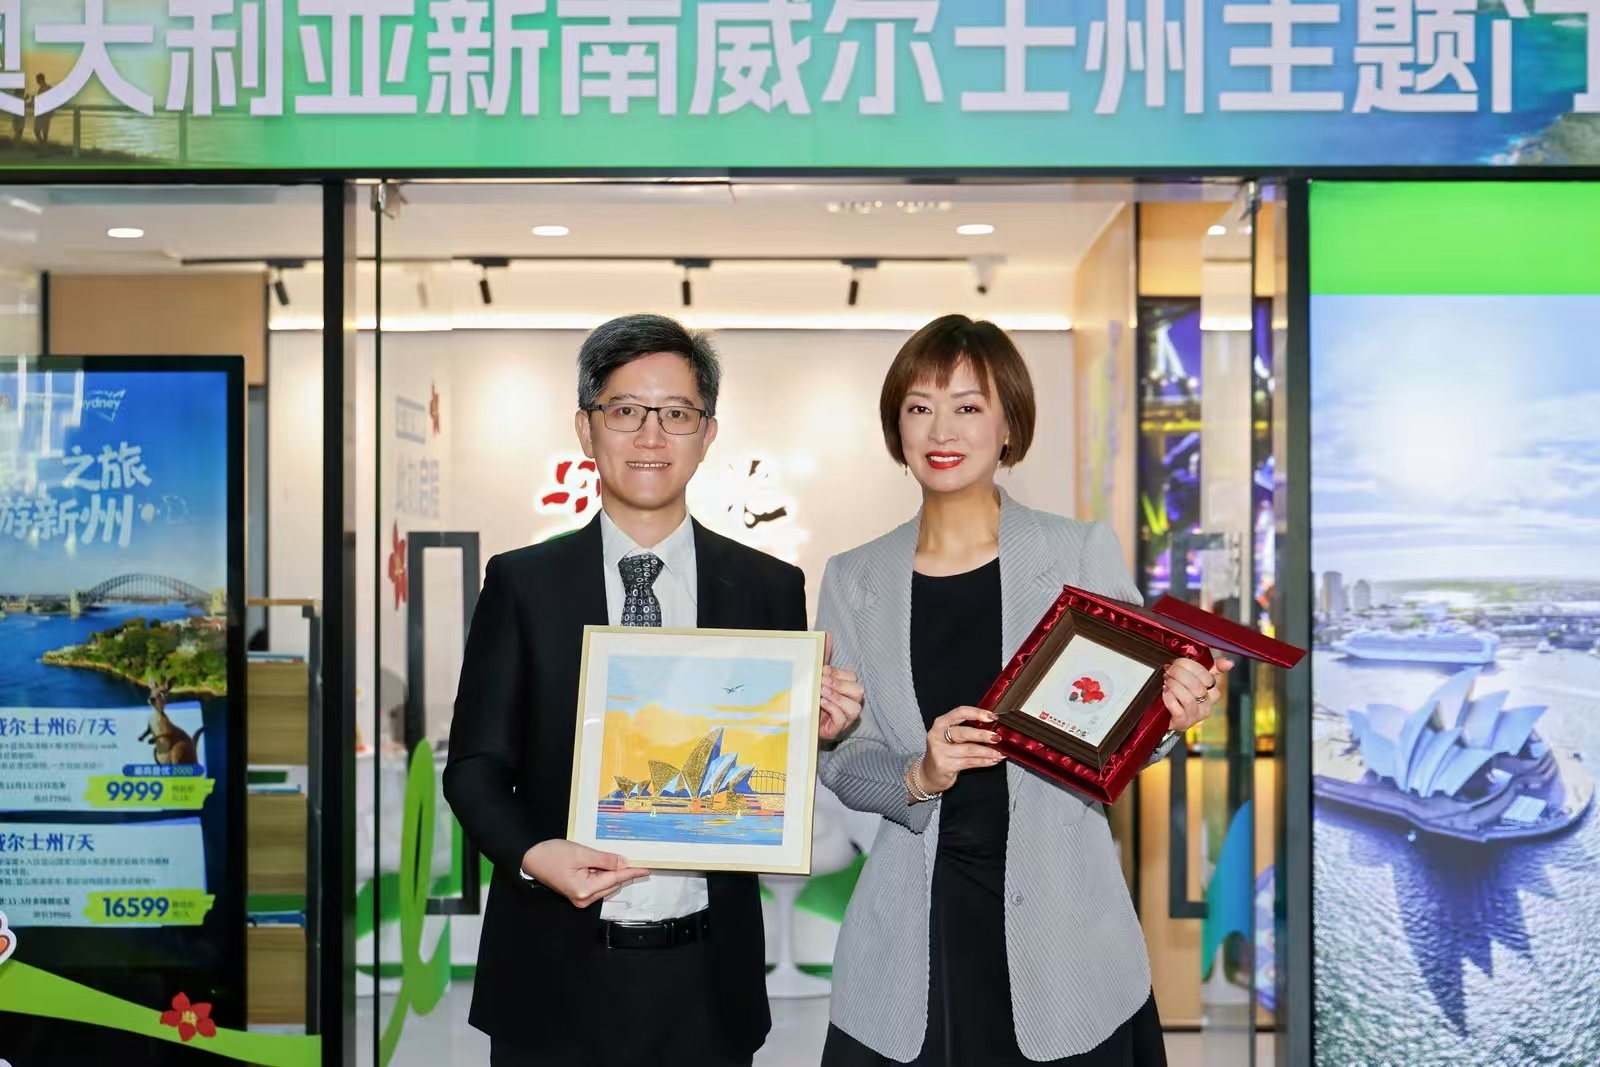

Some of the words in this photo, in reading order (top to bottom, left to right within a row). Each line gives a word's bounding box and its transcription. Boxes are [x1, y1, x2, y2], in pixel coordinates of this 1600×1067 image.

[0, 0, 1600, 116] 大利亚新南威尔士州主题门
[79, 397, 121, 411] ydney
[106, 780, 164, 801] 9999
[102, 896, 169, 918] 16599
